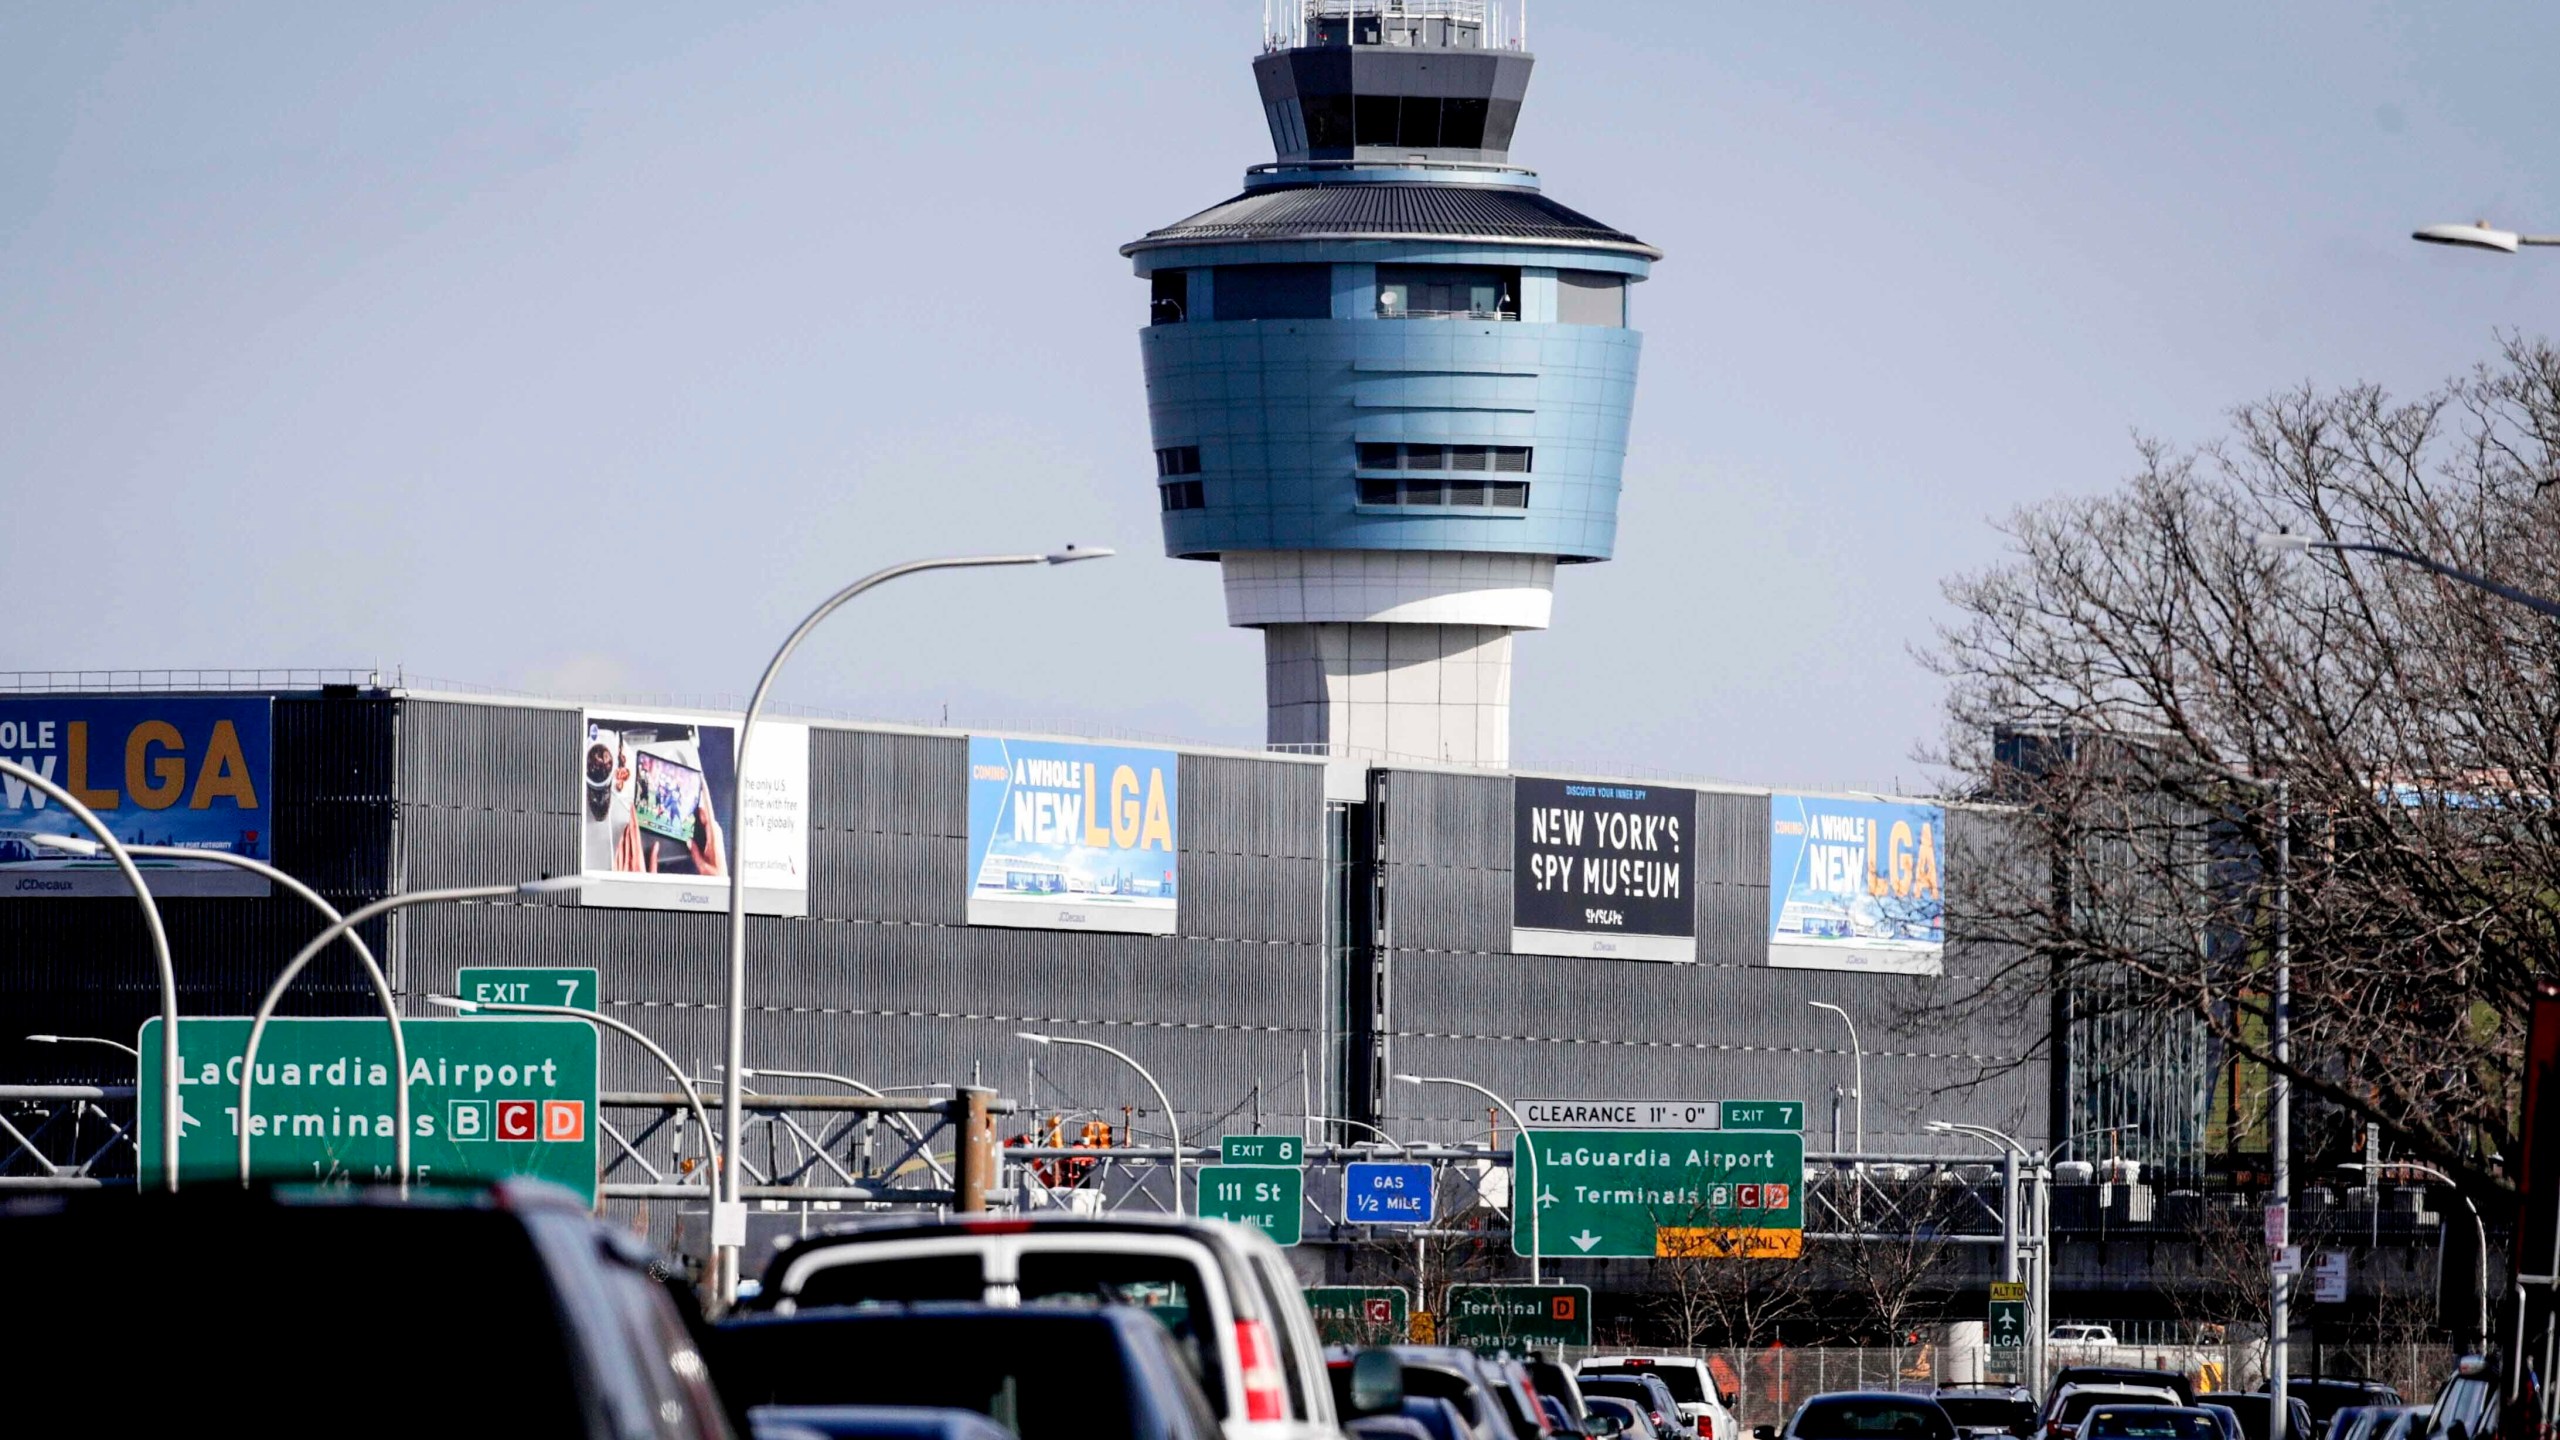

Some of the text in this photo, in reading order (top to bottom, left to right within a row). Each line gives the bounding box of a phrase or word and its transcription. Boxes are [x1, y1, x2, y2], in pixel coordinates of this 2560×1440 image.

[0, 721, 56, 749] OLE
[67, 720, 259, 810] LGA
[1015, 758, 1026, 785] A
[1027, 759, 1080, 788] WHOLE
[756, 778, 772, 794] only
[1566, 785, 1646, 800] DISCOVER YOUR INNER SPY
[744, 796, 797, 811] irline with free
[1084, 763, 1173, 852] LGA
[756, 815, 766, 827] TV
[767, 817, 795, 832] globally
[1014, 791, 1081, 845] NEW
[1532, 807, 1679, 853] NEW YORK'S
[1810, 815, 1820, 839] A
[1821, 815, 1865, 842] WHOLE
[1867, 819, 1939, 899] LGA
[1531, 853, 1679, 899] SPY MUSEUM
[1810, 844, 1865, 893] NEW
[15, 879, 73, 891] JCDecaux
[477, 980, 579, 1007] EXIT 7
[407, 1057, 556, 1093] Airport
[225, 1106, 576, 1137] Terminas B C D
[1528, 1106, 1636, 1122] CLEARANCE
[1732, 1108, 1793, 1124] EXIT 7
[1232, 1142, 1292, 1160] EXIT 8
[1546, 1148, 1774, 1171] LaGuardia Airport
[374, 1165, 431, 1186] ME
[1374, 1176, 1404, 1189] GAS
[1218, 1183, 1281, 1202] 111 St
[1575, 1186, 1784, 1205] Terminals B C D
[1387, 1197, 1421, 1210] MILE
[1240, 1214, 1275, 1227] MILE
[1744, 1236, 1792, 1250] ONLY
[1993, 1287, 2023, 1297] ALT TO
[1313, 1303, 1385, 1320] inal C
[1461, 1301, 1570, 1316] Terminal D
[1523, 1334, 1565, 1347] Gates
[1993, 1335, 2022, 1347] LGA
